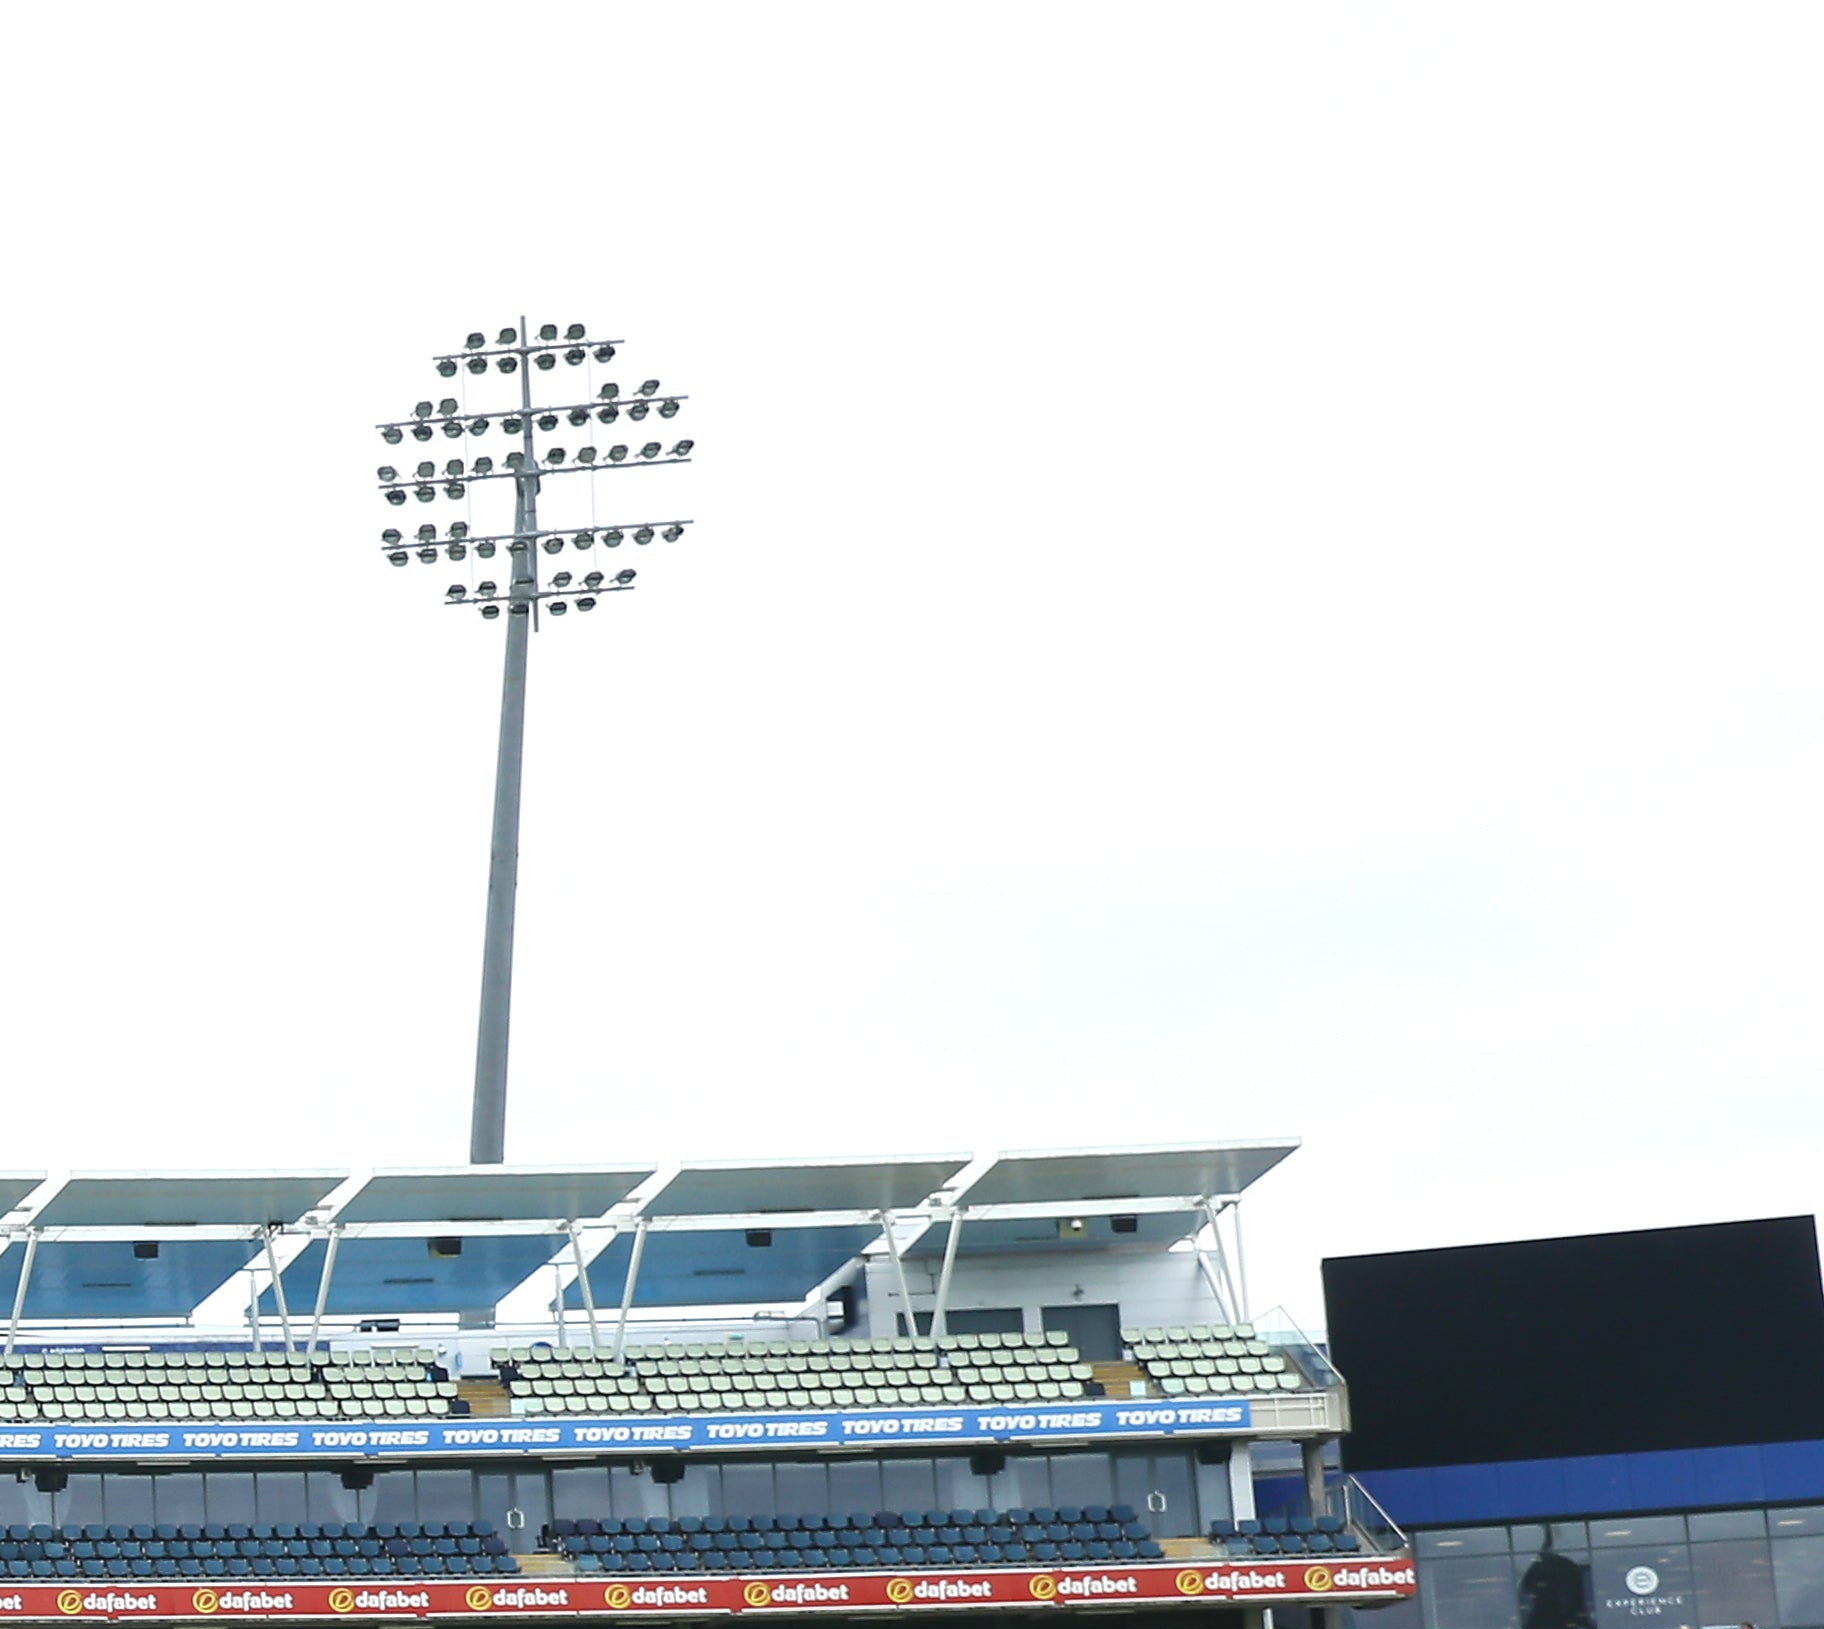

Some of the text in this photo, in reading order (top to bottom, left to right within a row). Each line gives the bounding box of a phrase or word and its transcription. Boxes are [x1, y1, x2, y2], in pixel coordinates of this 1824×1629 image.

[841, 1417, 963, 1434] TOYO TIRES
[977, 1413, 1102, 1431] TOYO TIRES
[1116, 1407, 1243, 1426] TOYO TIRES
[312, 1431, 429, 1446] TOYO TIRES
[443, 1429, 560, 1443] TOYO TIRES
[573, 1426, 692, 1441] TOYO TIRES
[707, 1422, 828, 1438] TOYO TIRES
[53, 1434, 169, 1448] TOYO TIRES
[182, 1433, 299, 1447] TOYO TIRES
[1056, 1576, 1137, 1595] dafabet
[1204, 1571, 1286, 1590] dafabet
[1333, 1568, 1416, 1588] dafabet
[492, 1588, 568, 1607] dafabet
[632, 1586, 707, 1605] dafabet
[771, 1583, 849, 1603] dafabet
[913, 1581, 992, 1600] dafabet
[83, 1592, 156, 1612] dafabet
[219, 1591, 293, 1611] dafabet
[355, 1591, 429, 1610] dafabet
